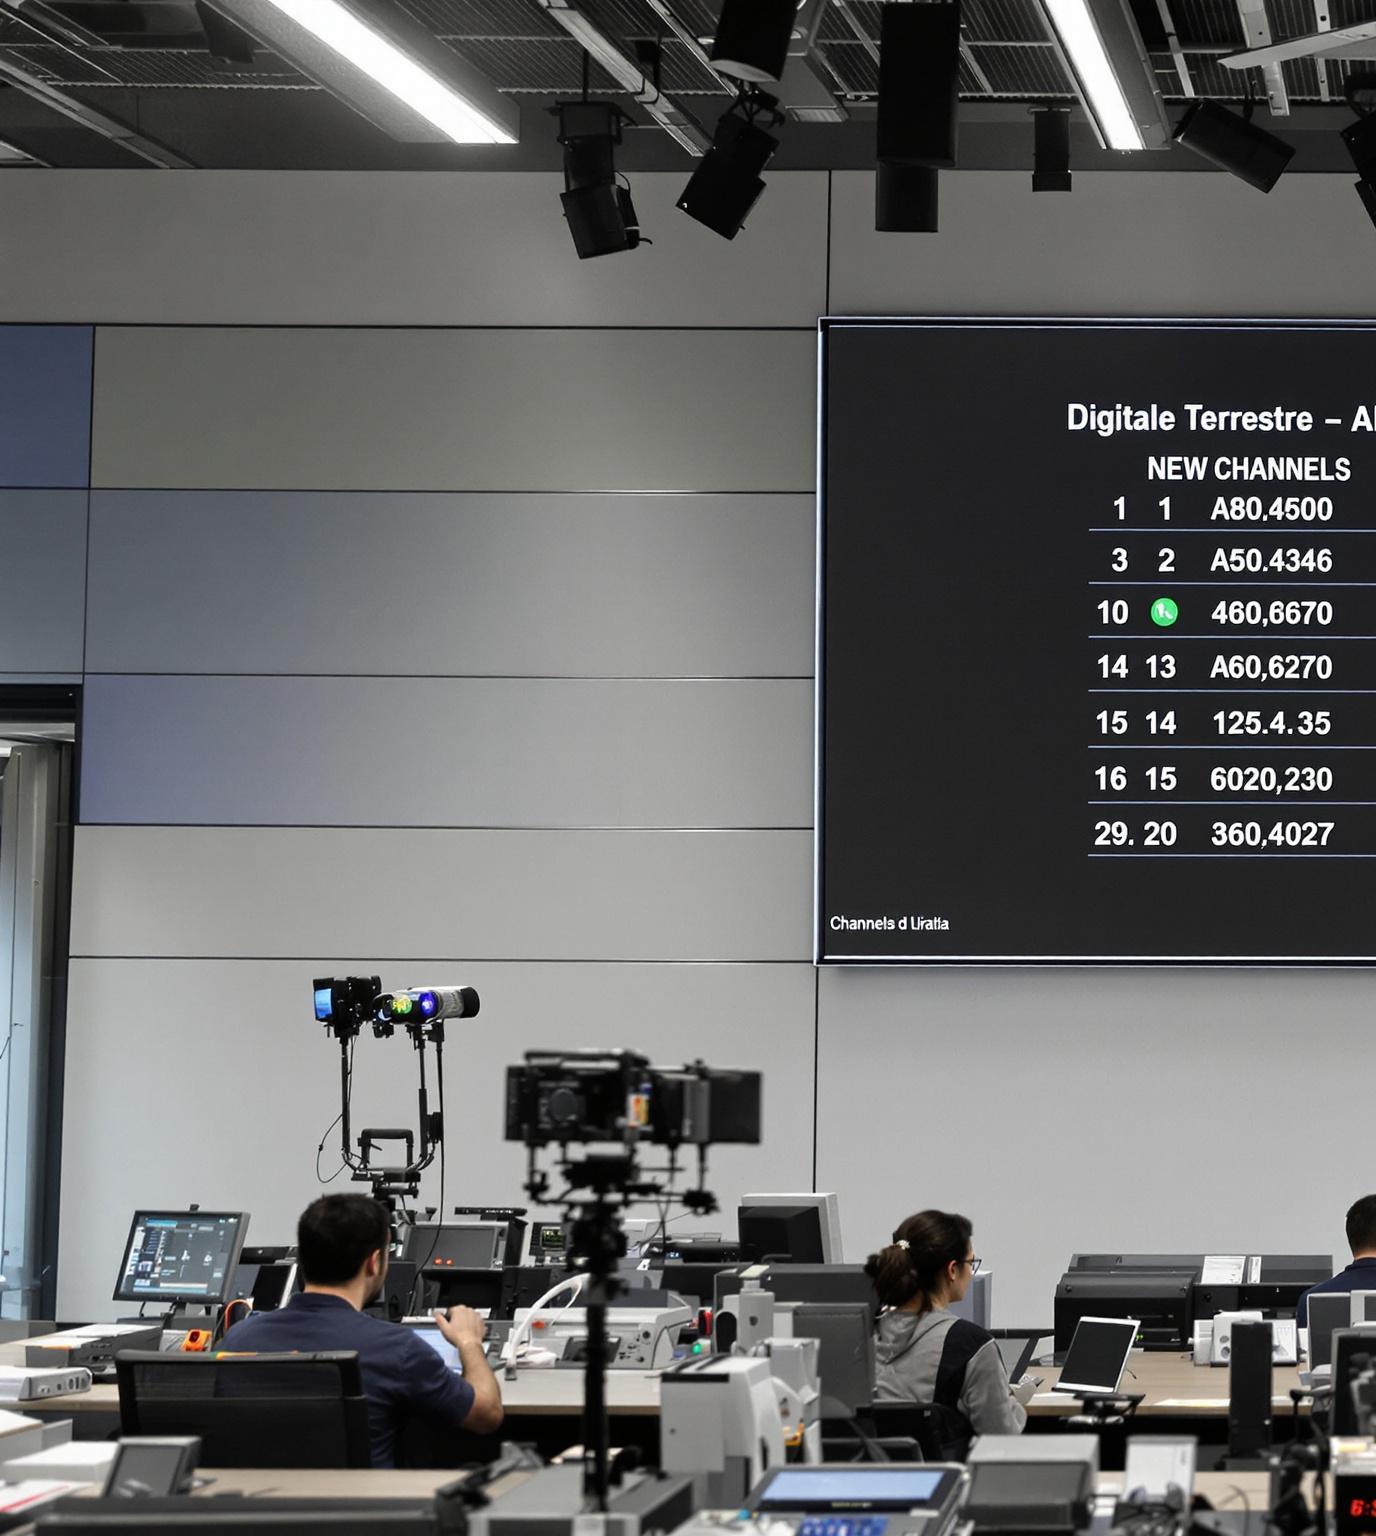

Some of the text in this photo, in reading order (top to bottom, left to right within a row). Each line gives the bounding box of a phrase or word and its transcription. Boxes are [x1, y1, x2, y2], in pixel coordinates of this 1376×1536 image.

[1067, 403, 1176, 437] Digitale
[1183, 403, 1314, 432] Terrestre
[1148, 455, 1209, 482] NEW
[1214, 456, 1351, 482] CHANNELS
[1113, 495, 1126, 521] 1
[1158, 496, 1171, 521] 1
[1111, 547, 1129, 573] 3
[1158, 547, 1175, 573] 2
[1210, 547, 1333, 573] A50.4346
[1097, 599, 1129, 625] 10
[1211, 600, 1333, 628] 460,6670
[1097, 654, 1129, 679] 14
[1145, 654, 1177, 679] 13
[1210, 654, 1333, 682] A60,6270
[1096, 709, 1128, 735] 15
[1145, 710, 1177, 735] 14
[1094, 765, 1127, 791] 16
[1145, 766, 1177, 791] 15
[1210, 766, 1333, 795] 6020,230
[1143, 820, 1177, 847] 20
[830, 915, 896, 931] Channels
